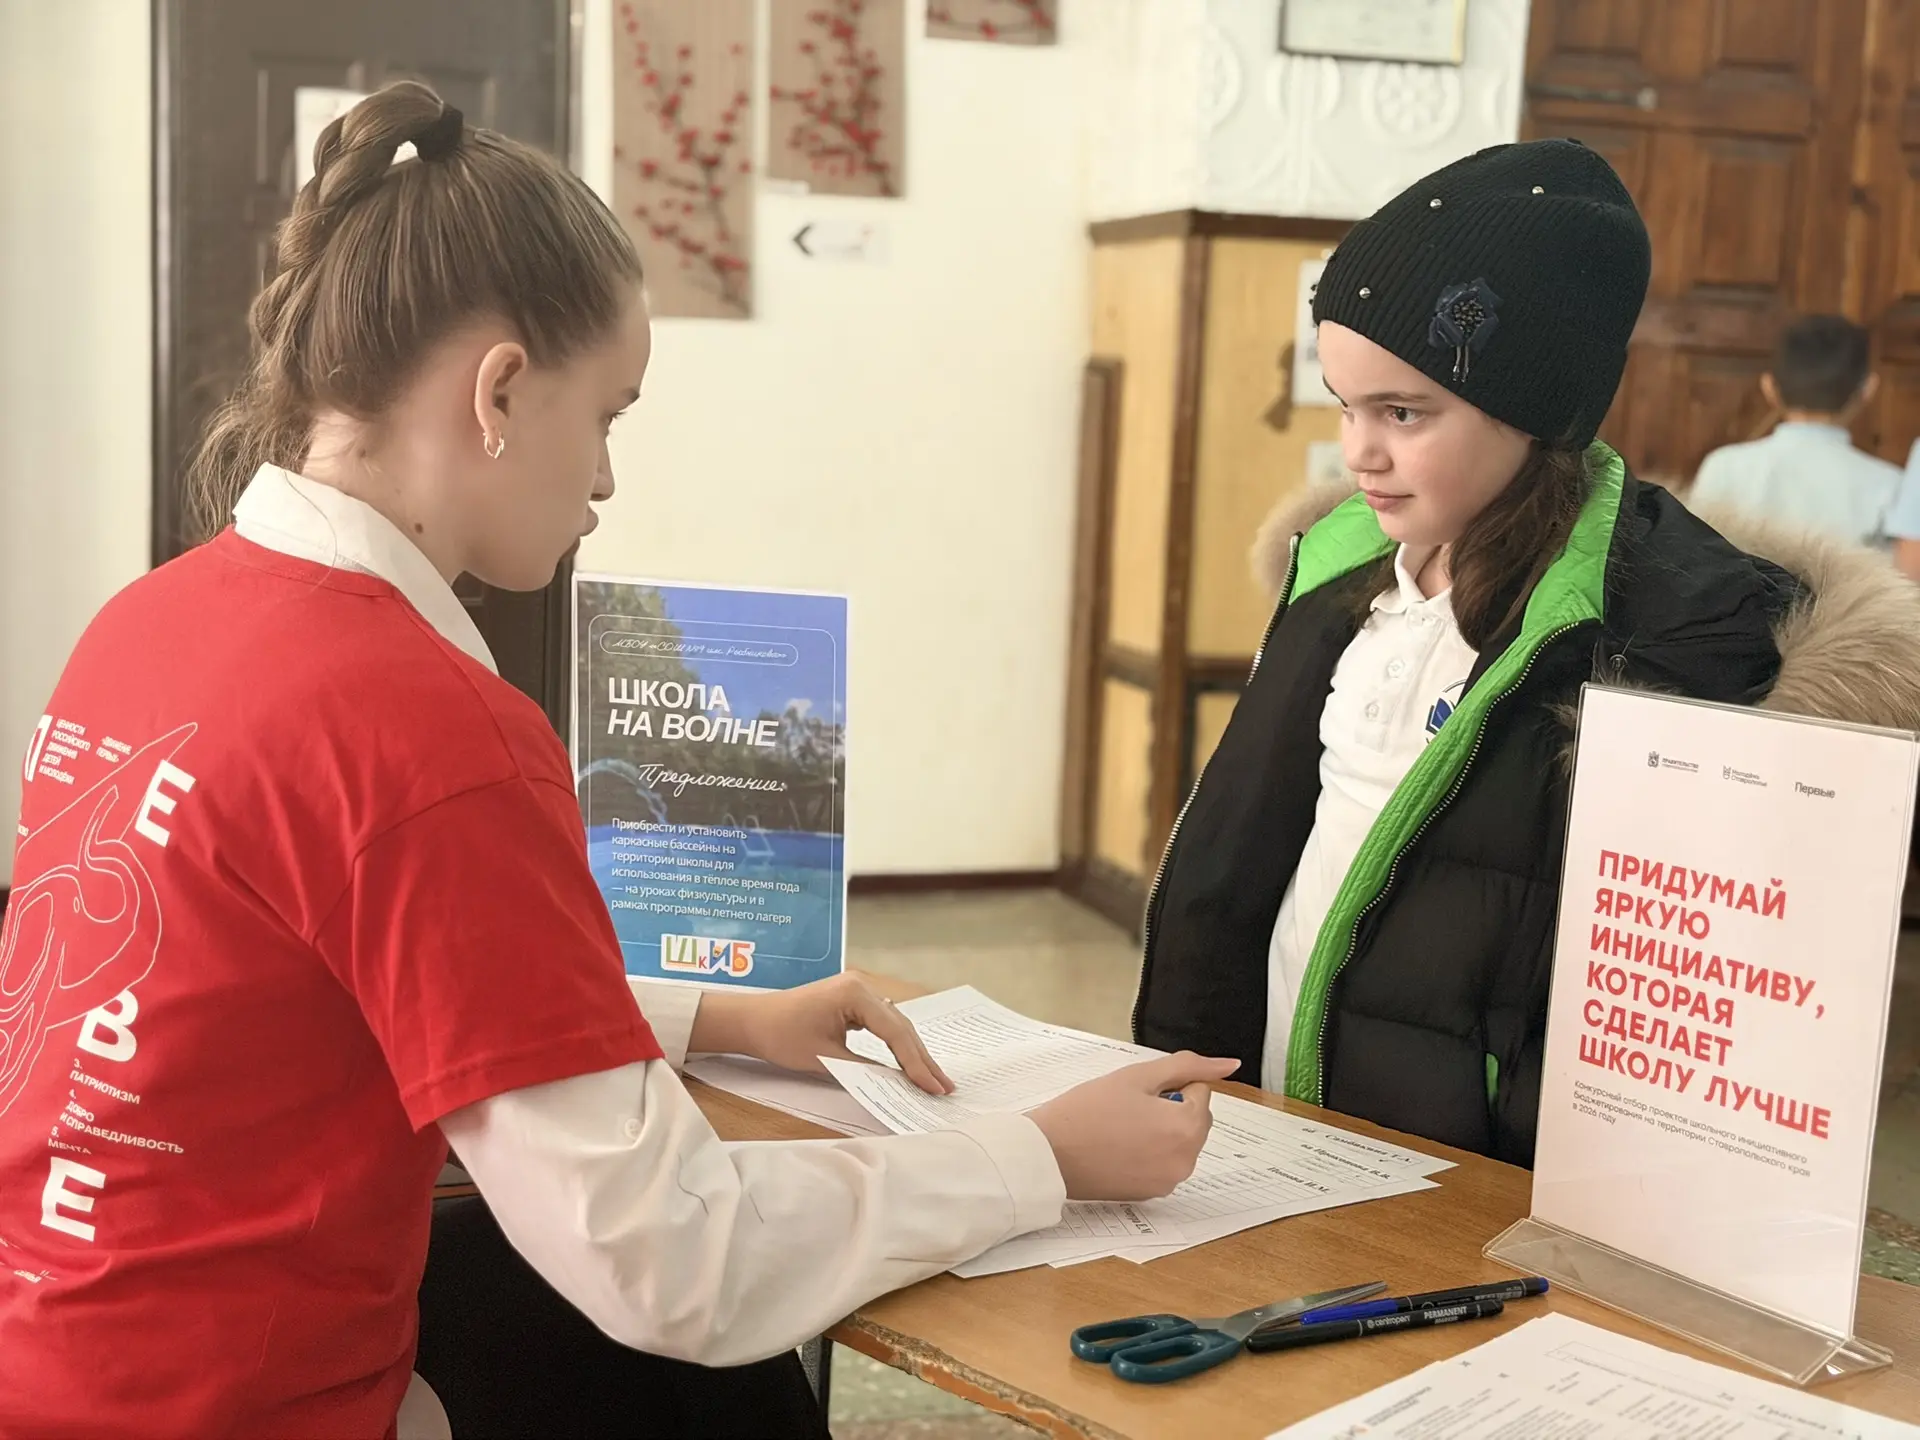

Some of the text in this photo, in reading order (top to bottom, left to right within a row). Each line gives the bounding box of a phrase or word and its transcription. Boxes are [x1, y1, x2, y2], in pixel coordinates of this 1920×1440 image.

[608, 677, 731, 712] ШКОЛА
[607, 709, 780, 747] НА ВОЛНЕ
[638, 763, 786, 798] Предложение:
[1795, 782, 1836, 799] Первые
[135, 759, 196, 848] Е
[612, 818, 748, 840] Приобрести и установить
[612, 837, 736, 854] каркасные бассейны на
[612, 852, 735, 871] территории школы для
[612, 869, 800, 894] использования в тёплое время года
[625, 885, 638, 893] на
[640, 886, 676, 897] уроках
[677, 887, 747, 905] физкультуры
[750, 896, 757, 904] и
[759, 897, 765, 905] в
[1599, 849, 1787, 920] ПРИДУМАЙ
[612, 900, 792, 925] рамках программы летнего лагеря
[1594, 888, 1711, 940] ЯРКУЮ
[1590, 924, 1825, 1019] ИНИЦИАТИВУ,
[1587, 960, 1735, 1028] КОТОРАЯ
[76, 989, 139, 1062] В
[1583, 999, 1733, 1066] СДЕЛАЕТ
[74, 1058, 83, 1070] 3.
[69, 1070, 140, 1105] ПАТРИОТИЗМ
[1579, 1034, 1831, 1140] ШКОЛУ ЛУЧШЕ
[65, 1100, 95, 1122] ДОБРО
[1579, 1104, 1597, 1117] 2026
[1599, 1111, 1617, 1125] году
[48, 1138, 92, 1155] МЕЧТА
[51, 1125, 60, 1138] 5.
[66, 1116, 184, 1154] СПРАВЕДЛИВОСТЬ
[1573, 1091, 1811, 1177] бюджетирования на территории Ставропольского края
[1623, 1096, 1648, 1111] отбор
[1649, 1106, 1688, 1125] проектов
[1689, 1120, 1737, 1141] школьного
[1738, 1136, 1808, 1164] инициативного
[40, 1156, 106, 1242] Е
[1374, 1315, 1411, 1329] centropen
[1424, 1306, 1467, 1319] PERMANENT
